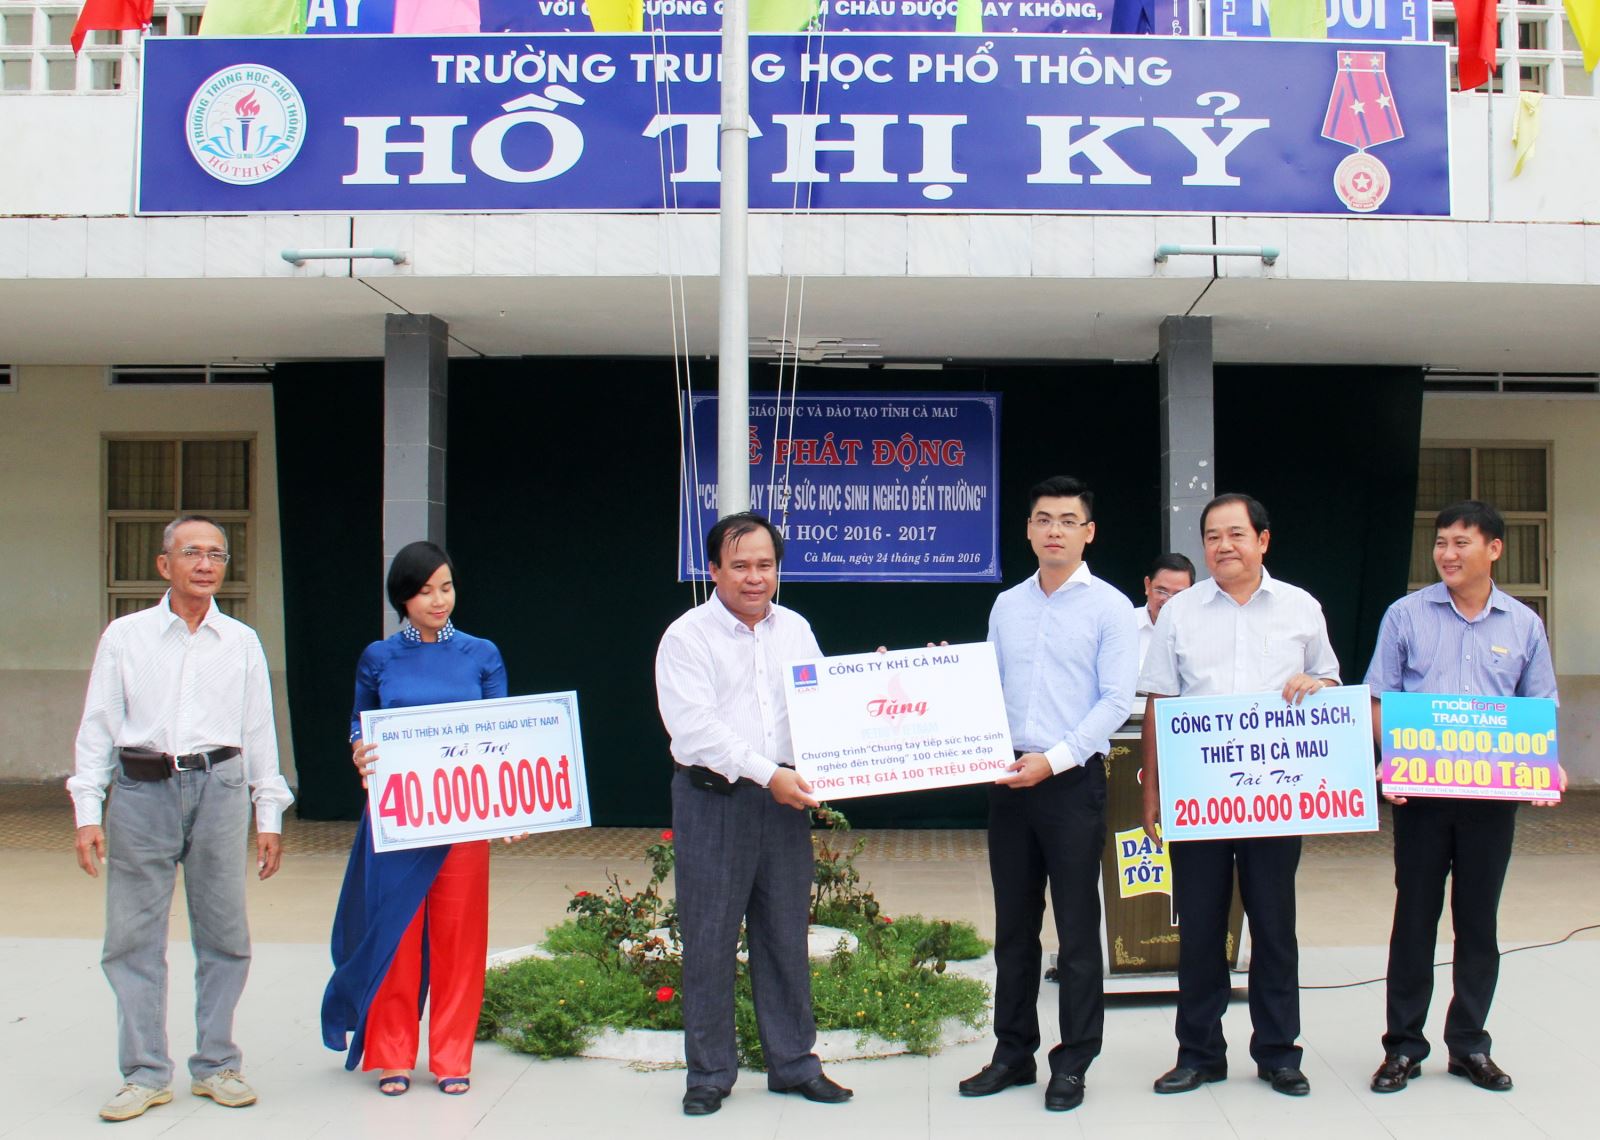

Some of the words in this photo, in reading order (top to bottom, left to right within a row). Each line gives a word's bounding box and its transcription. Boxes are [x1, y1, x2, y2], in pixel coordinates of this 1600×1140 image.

[983, 2, 1013, 17] AY
[1019, 0, 1103, 20] KHÔNG,
[431, 44, 616, 84] TRƯỜNG
[630, 53, 786, 83] TRUG
[800, 53, 893, 91] HỌC
[909, 41, 998, 84] PHỔ
[1014, 47, 1172, 86] THÔNG
[342, 85, 586, 184] HỒ
[642, 114, 967, 200] THỊ
[1026, 91, 1270, 186] KỶ
[748, 404, 776, 417] GIÁO
[806, 404, 823, 417] VÀ
[827, 404, 851, 417] ĐÀO
[854, 406, 878, 420] TẠO
[913, 404, 929, 417] CÀ
[932, 407, 958, 417] MAU
[774, 432, 863, 465] PHÁT
[872, 433, 965, 472] ĐỘNG
[750, 484, 764, 510] AY
[795, 478, 816, 511] SỨC
[819, 485, 841, 516] HỌC
[844, 485, 870, 511] SINH
[873, 478, 909, 511] NGHÈO
[912, 475, 935, 511] ĐẾN
[797, 525, 838, 544] HỌC
[844, 526, 882, 541] 2016
[899, 526, 937, 541] 2017
[804, 552, 818, 563] Cà
[822, 552, 846, 564] Mau,
[849, 552, 874, 564] ngày
[877, 553, 888, 563] 24
[891, 552, 921, 564] tháng
[932, 553, 955, 563] năm
[958, 553, 981, 563] 2016
[828, 662, 864, 676] CÔNG
[867, 662, 882, 672] TY
[886, 656, 909, 669] KHÍ
[912, 654, 929, 667] CÀ
[932, 654, 960, 665] MAU
[866, 698, 929, 719] Tặng
[1431, 698, 1507, 712] mobifone
[382, 731, 400, 742] BAN
[415, 727, 439, 739] THIỆN
[455, 724, 469, 735] HỘI
[475, 721, 496, 733] PHẬT
[499, 720, 518, 730] GIÁO
[521, 718, 537, 728] VIỆT
[540, 716, 559, 726] NAM
[1171, 712, 1211, 734] CÔNG
[1215, 714, 1234, 731] TY
[1239, 702, 1259, 730] CỔ
[1265, 703, 1306, 729] PHẦN
[1311, 702, 1356, 727] SÁCH,
[1432, 713, 1469, 724] TRAO
[440, 743, 469, 758] Hỗ
[478, 741, 510, 756] Trợ
[905, 741, 921, 750] tay
[923, 738, 942, 748] tiếp
[964, 734, 982, 744] học
[984, 732, 1004, 741] sinh
[1201, 738, 1244, 764] THIẾT
[1251, 744, 1266, 765] BỊ
[1270, 737, 1290, 760] CÀ
[1296, 740, 1329, 759] MAU
[913, 752, 931, 761] 100
[975, 745, 993, 755] đạp
[809, 776, 845, 790] TỔNG
[848, 774, 871, 787] TRỊ
[874, 769, 898, 783] GIÁ
[902, 768, 924, 780] 100
[928, 762, 966, 776] TRIỆU
[969, 759, 1006, 772] ĐỒNG
[1229, 772, 1262, 787] Tài
[1270, 770, 1303, 787] Trợ
[1390, 757, 1492, 786] 20.000
[379, 755, 573, 828] 40.000.000đ
[1175, 793, 1293, 827] 20.000.000
[1299, 778, 1365, 820] ĐỒNG
[1124, 860, 1164, 885] TỐT
